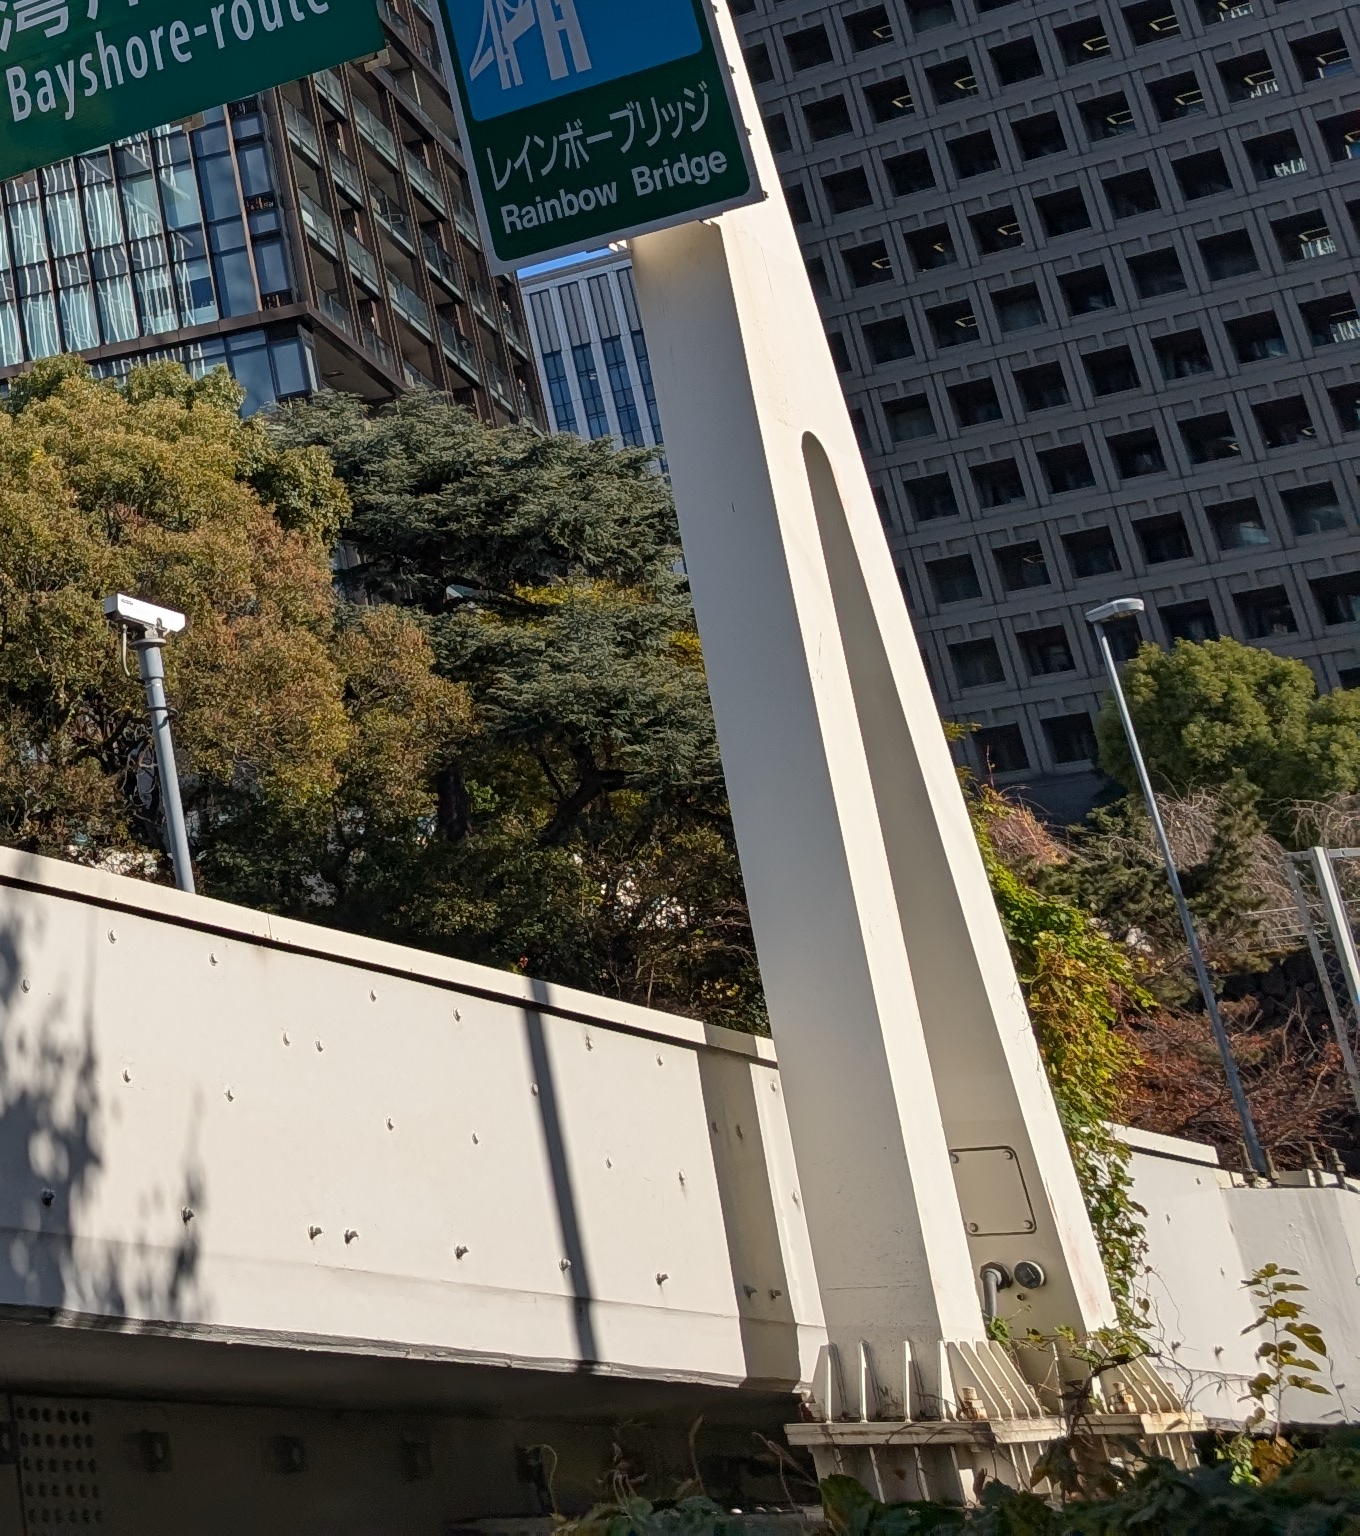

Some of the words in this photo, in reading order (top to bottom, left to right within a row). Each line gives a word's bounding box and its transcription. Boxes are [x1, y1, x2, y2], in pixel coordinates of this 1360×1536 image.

[486, 80, 709, 191] レインボーブリッジ
[500, 181, 617, 234] Rainbow
[631, 150, 728, 197] Bridge
